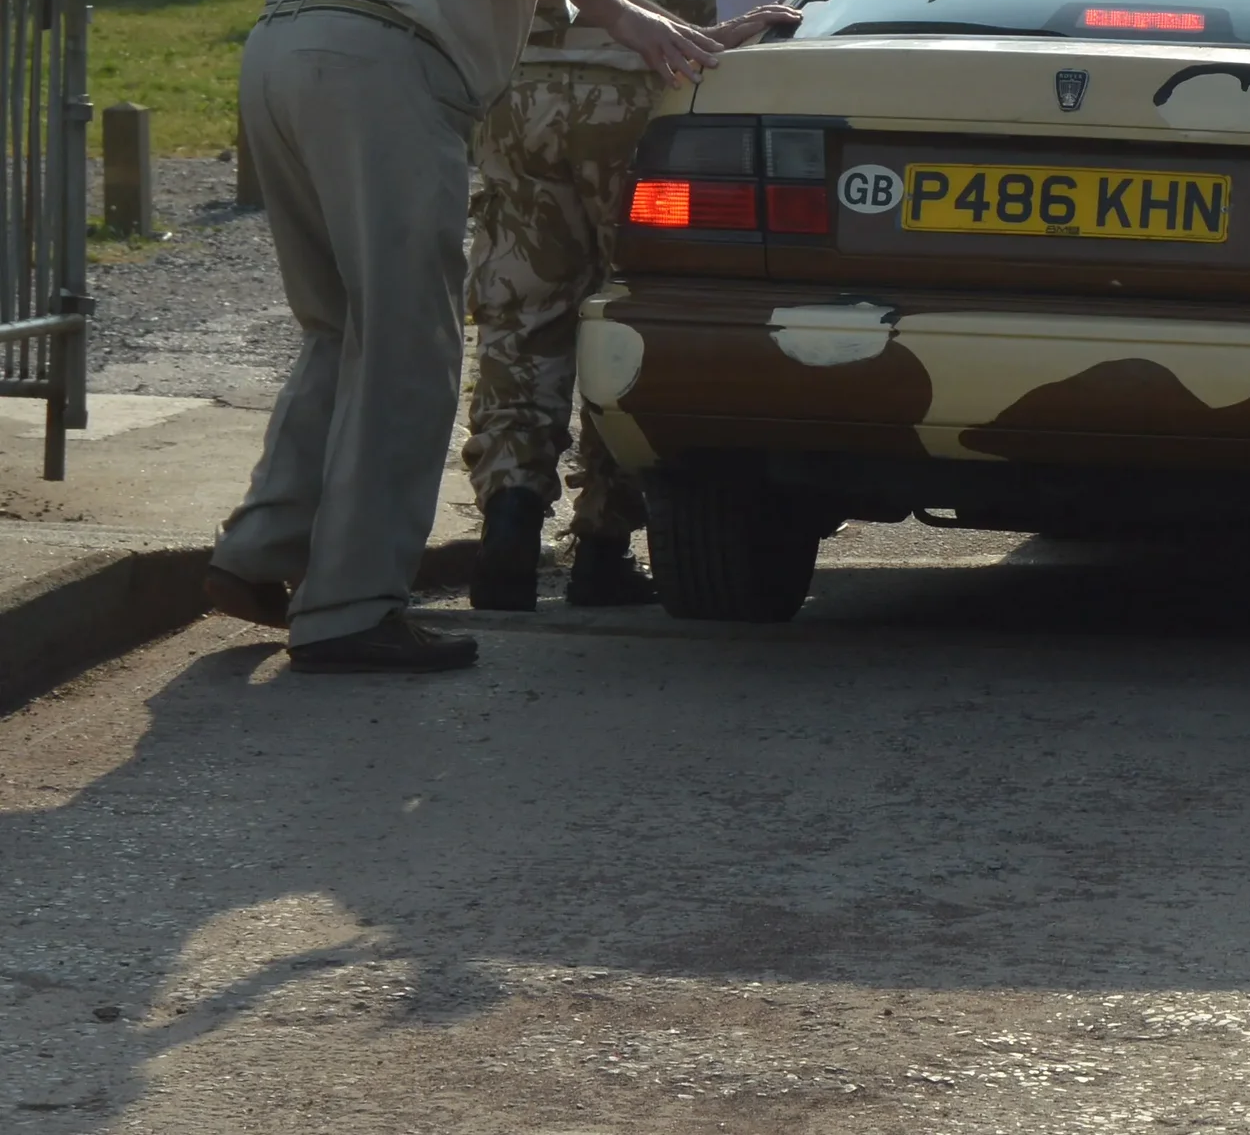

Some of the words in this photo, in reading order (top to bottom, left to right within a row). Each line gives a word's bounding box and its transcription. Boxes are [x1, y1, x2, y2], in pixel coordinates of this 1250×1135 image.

[844, 172, 894, 207] GB
[911, 171, 1077, 226] P486
[1096, 177, 1222, 233] KHN
